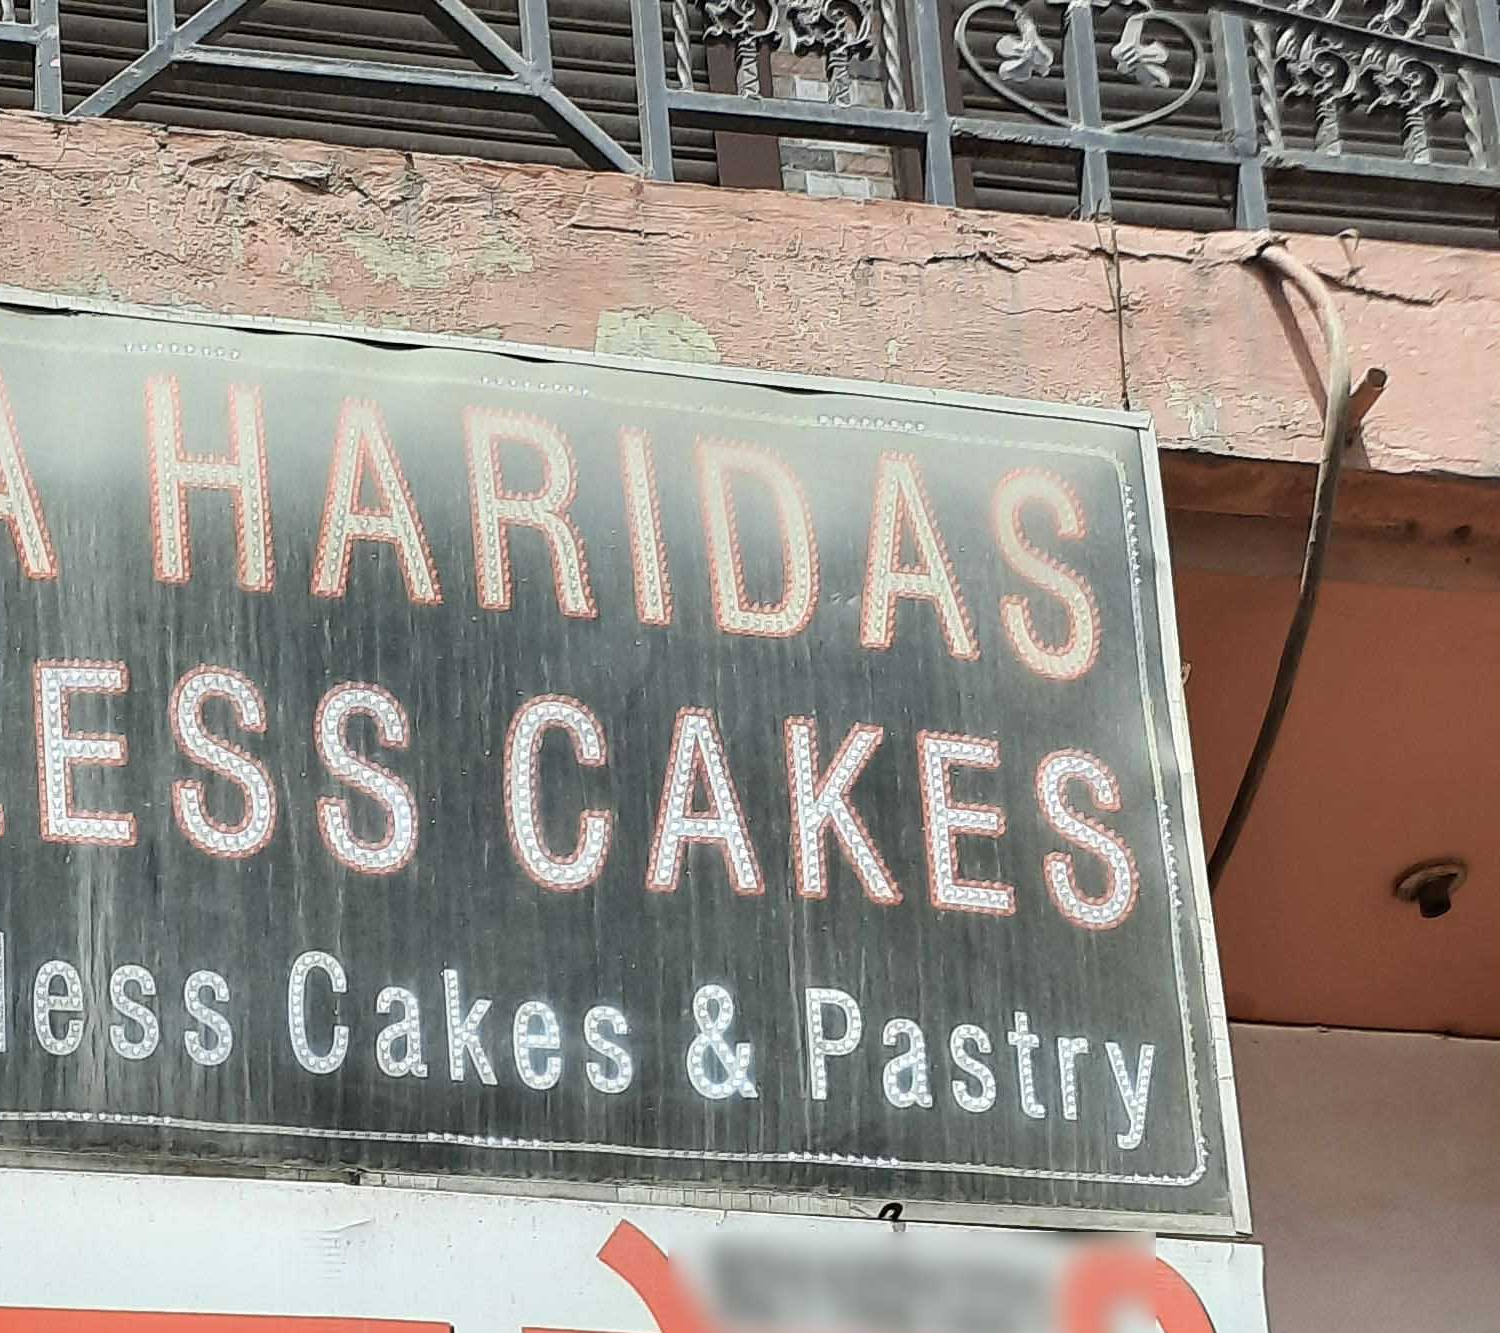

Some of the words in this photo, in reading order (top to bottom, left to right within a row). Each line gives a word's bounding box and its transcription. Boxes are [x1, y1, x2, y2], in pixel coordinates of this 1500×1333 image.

[145, 374, 1101, 680] HARIDAS
[503, 692, 1140, 928] CAKES
[285, 950, 635, 1095] Cakes
[685, 984, 759, 1100] &
[806, 986, 1156, 1150] Pastry
